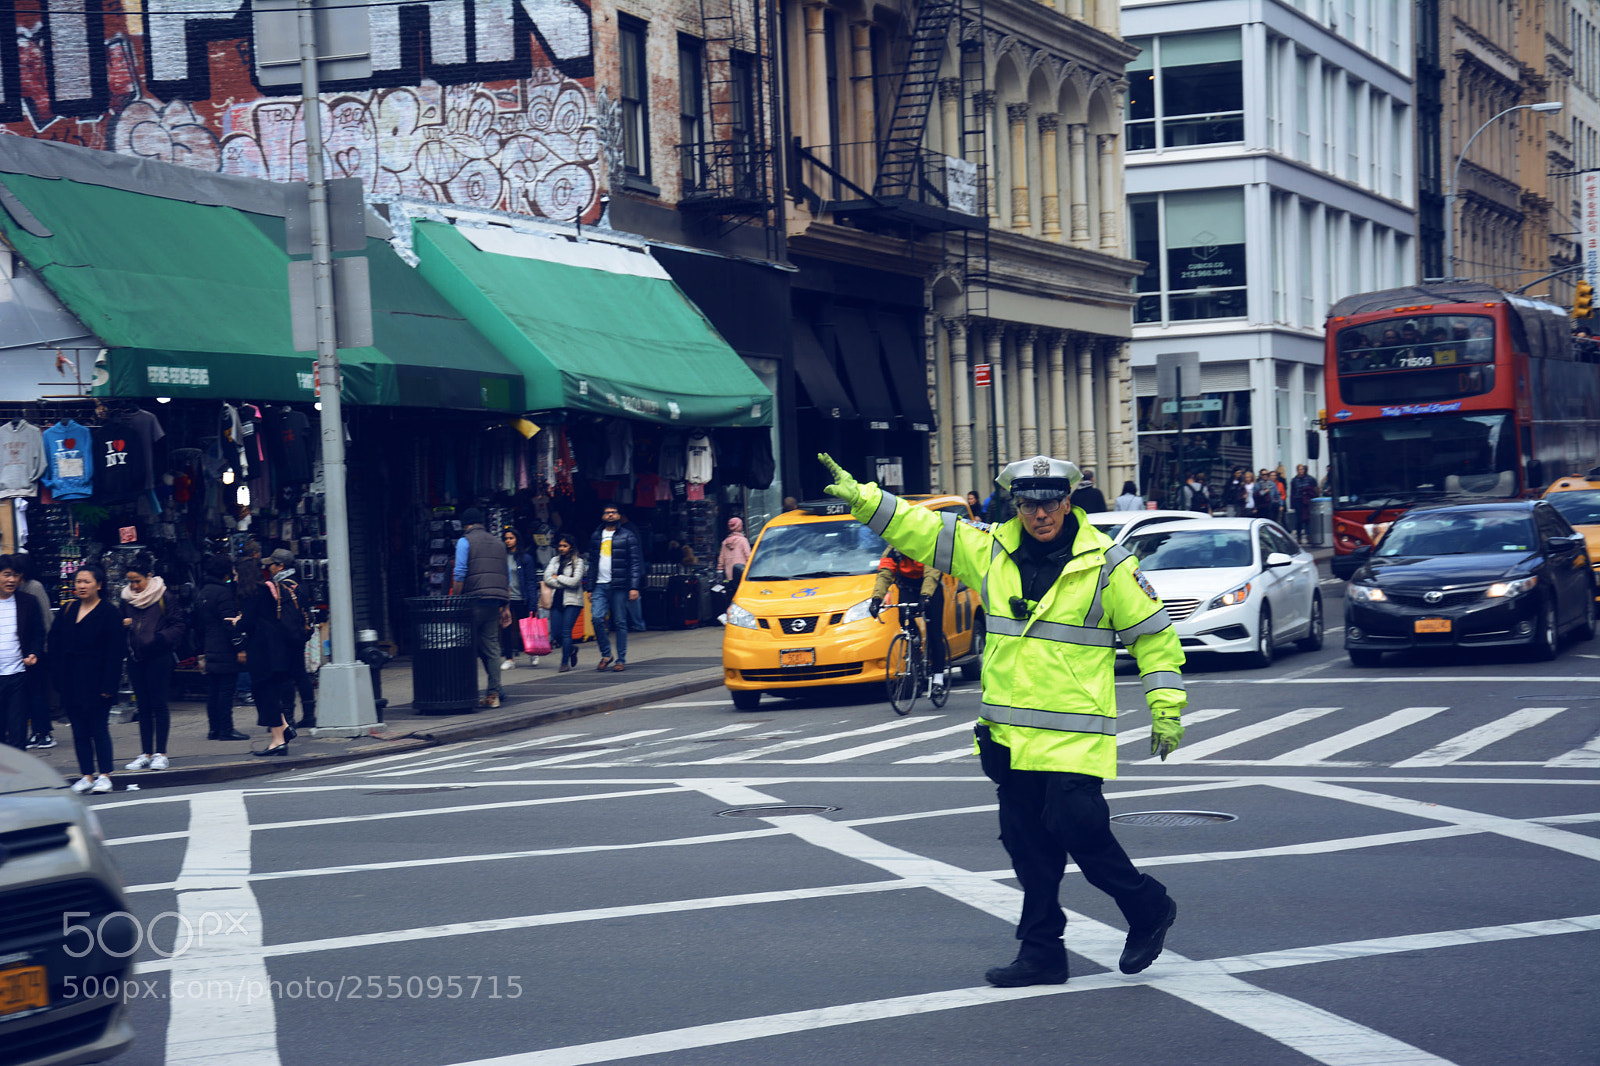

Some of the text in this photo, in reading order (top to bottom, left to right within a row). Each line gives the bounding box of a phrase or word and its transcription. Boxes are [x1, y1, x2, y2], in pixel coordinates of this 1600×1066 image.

[1400, 356, 1433, 367] 71509
[55, 439, 65, 451] I
[105, 440, 115, 453] I
[105, 452, 128, 467] NY
